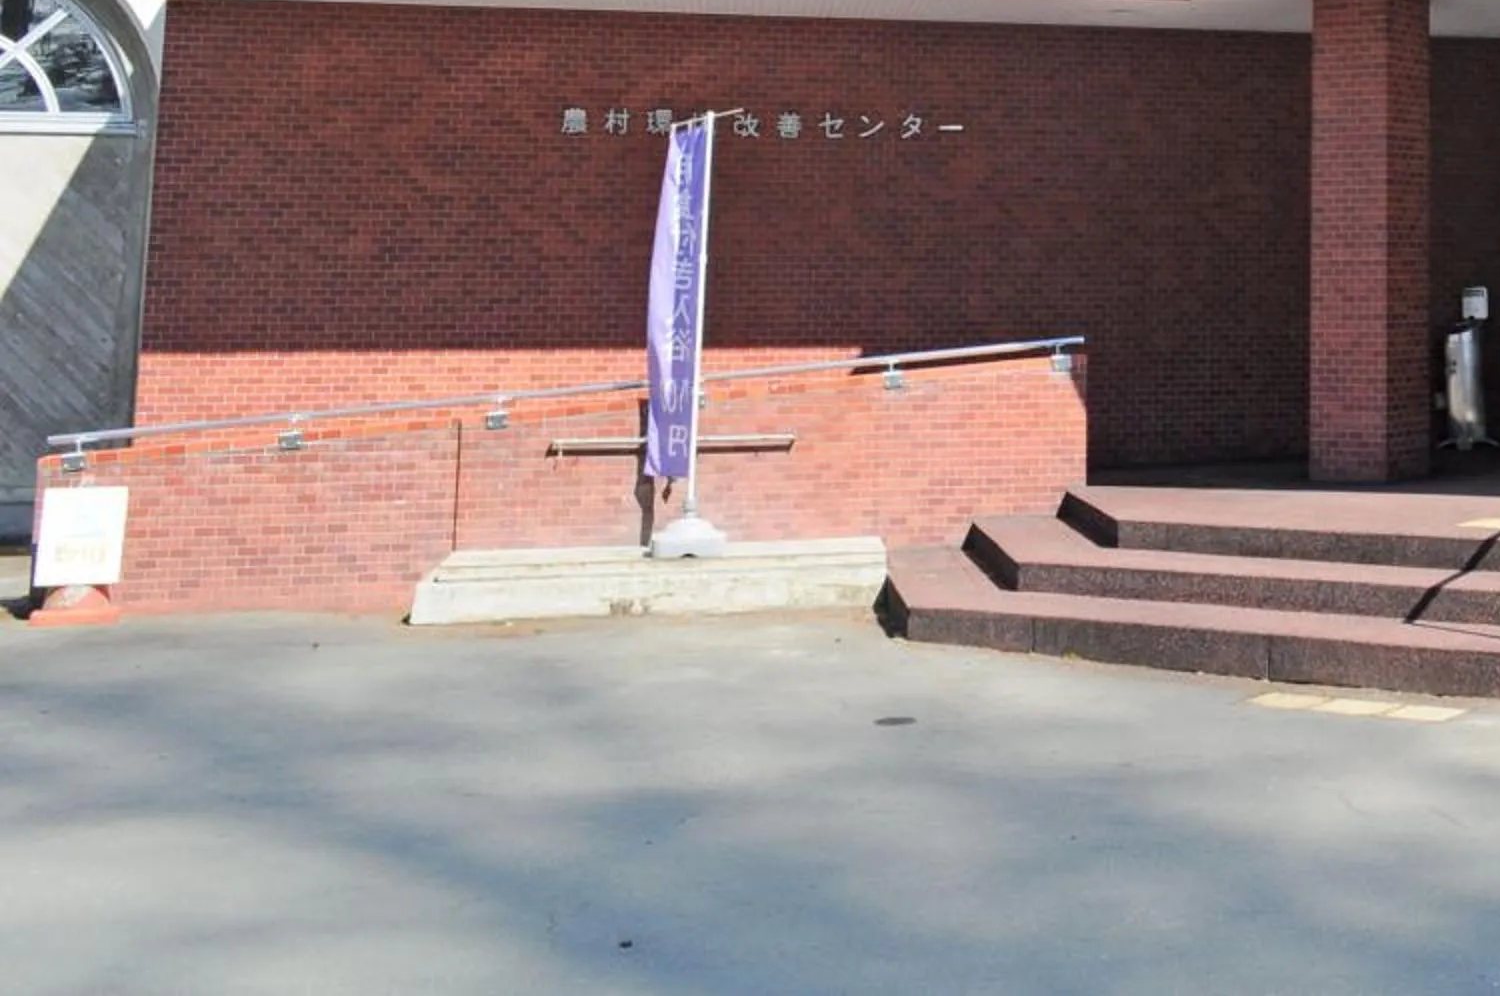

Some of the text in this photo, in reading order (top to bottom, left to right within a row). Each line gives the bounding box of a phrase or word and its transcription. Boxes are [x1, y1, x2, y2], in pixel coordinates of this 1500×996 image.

[561, 107, 964, 137] 農村環改善センター
